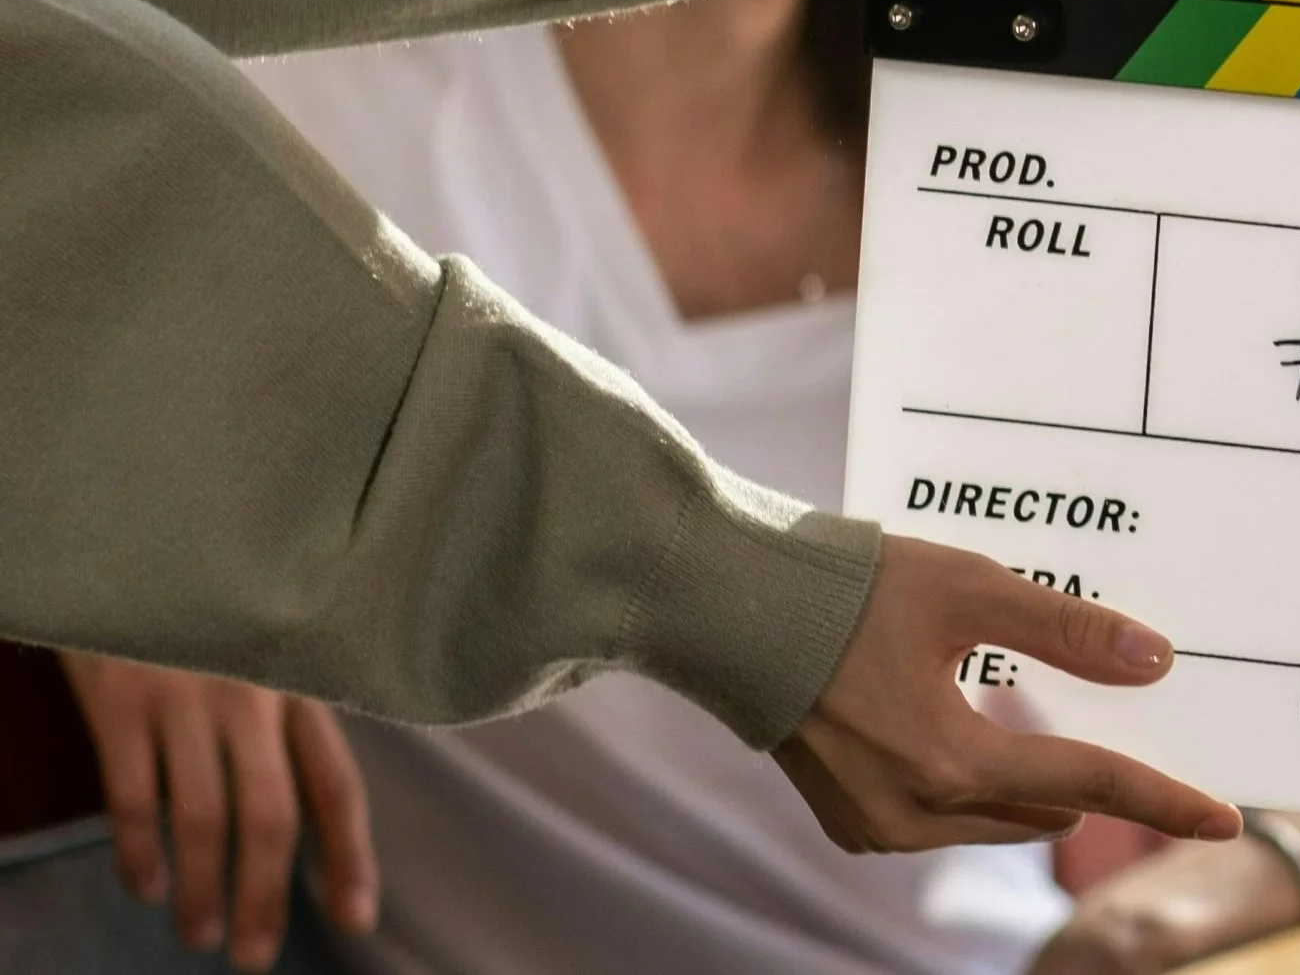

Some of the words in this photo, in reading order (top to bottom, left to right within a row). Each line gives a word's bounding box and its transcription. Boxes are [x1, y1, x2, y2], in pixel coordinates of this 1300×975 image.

[930, 144, 1055, 188] PROD.
[985, 215, 1091, 258] ROLL
[907, 478, 1140, 533] DIRECTOR:
[958, 651, 1018, 688] TE:
